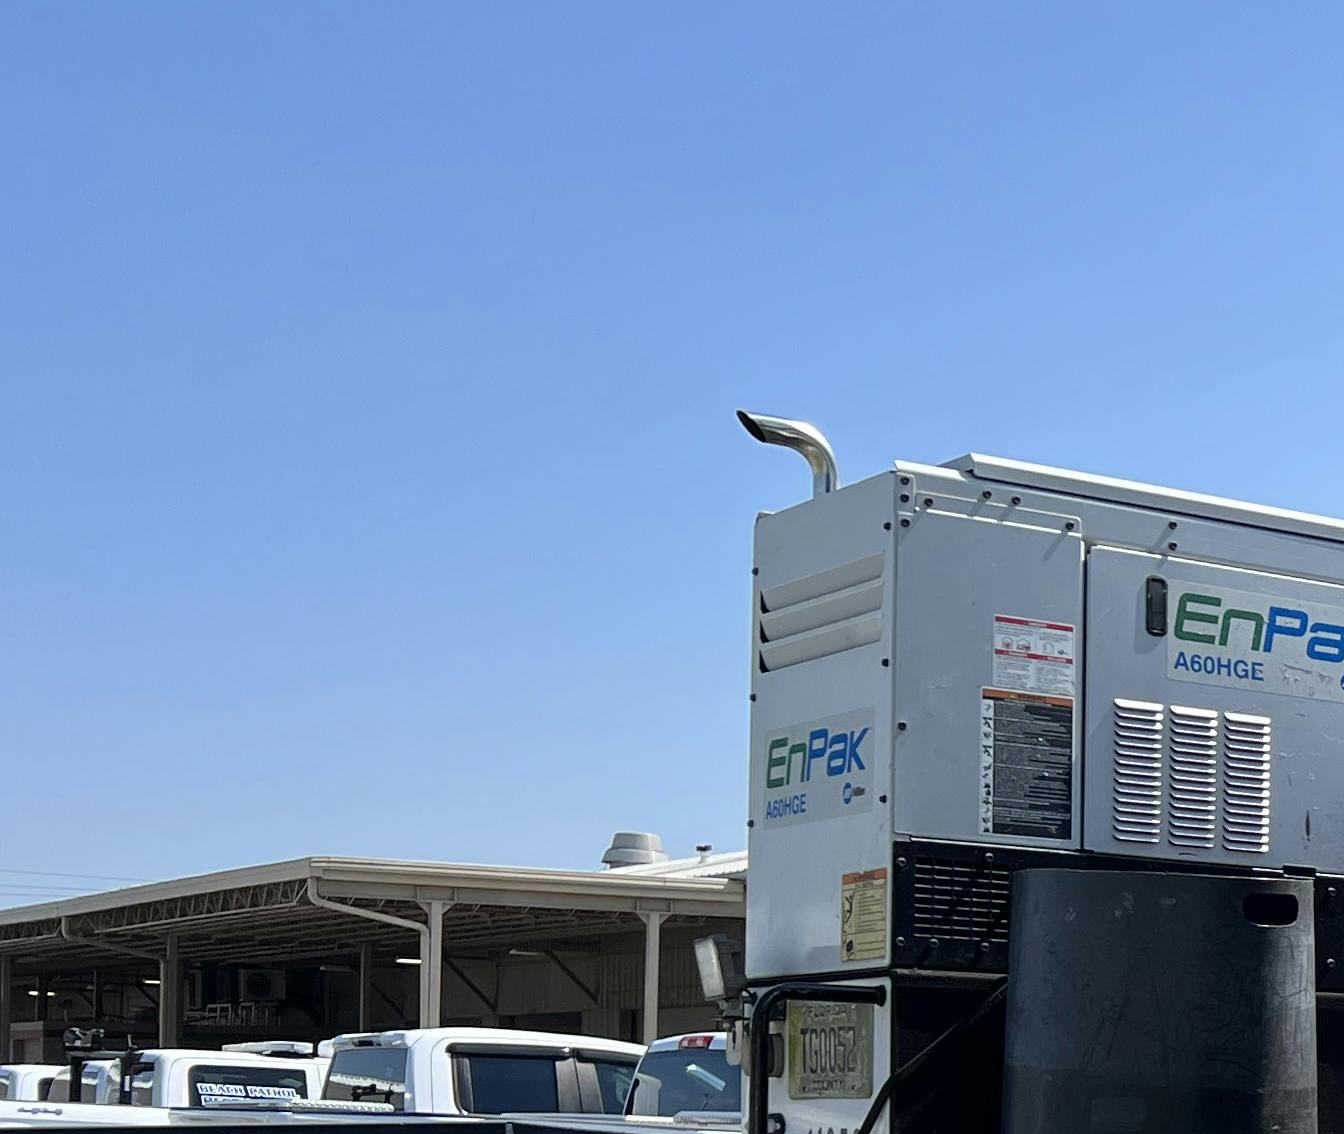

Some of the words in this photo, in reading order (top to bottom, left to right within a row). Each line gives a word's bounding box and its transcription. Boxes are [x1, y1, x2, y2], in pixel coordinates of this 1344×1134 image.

[1174, 651, 1265, 682] A60HGE
[766, 727, 871, 789] EnPak
[766, 793, 807, 819] A60HGE
[198, 1084, 244, 1096] BEACH
